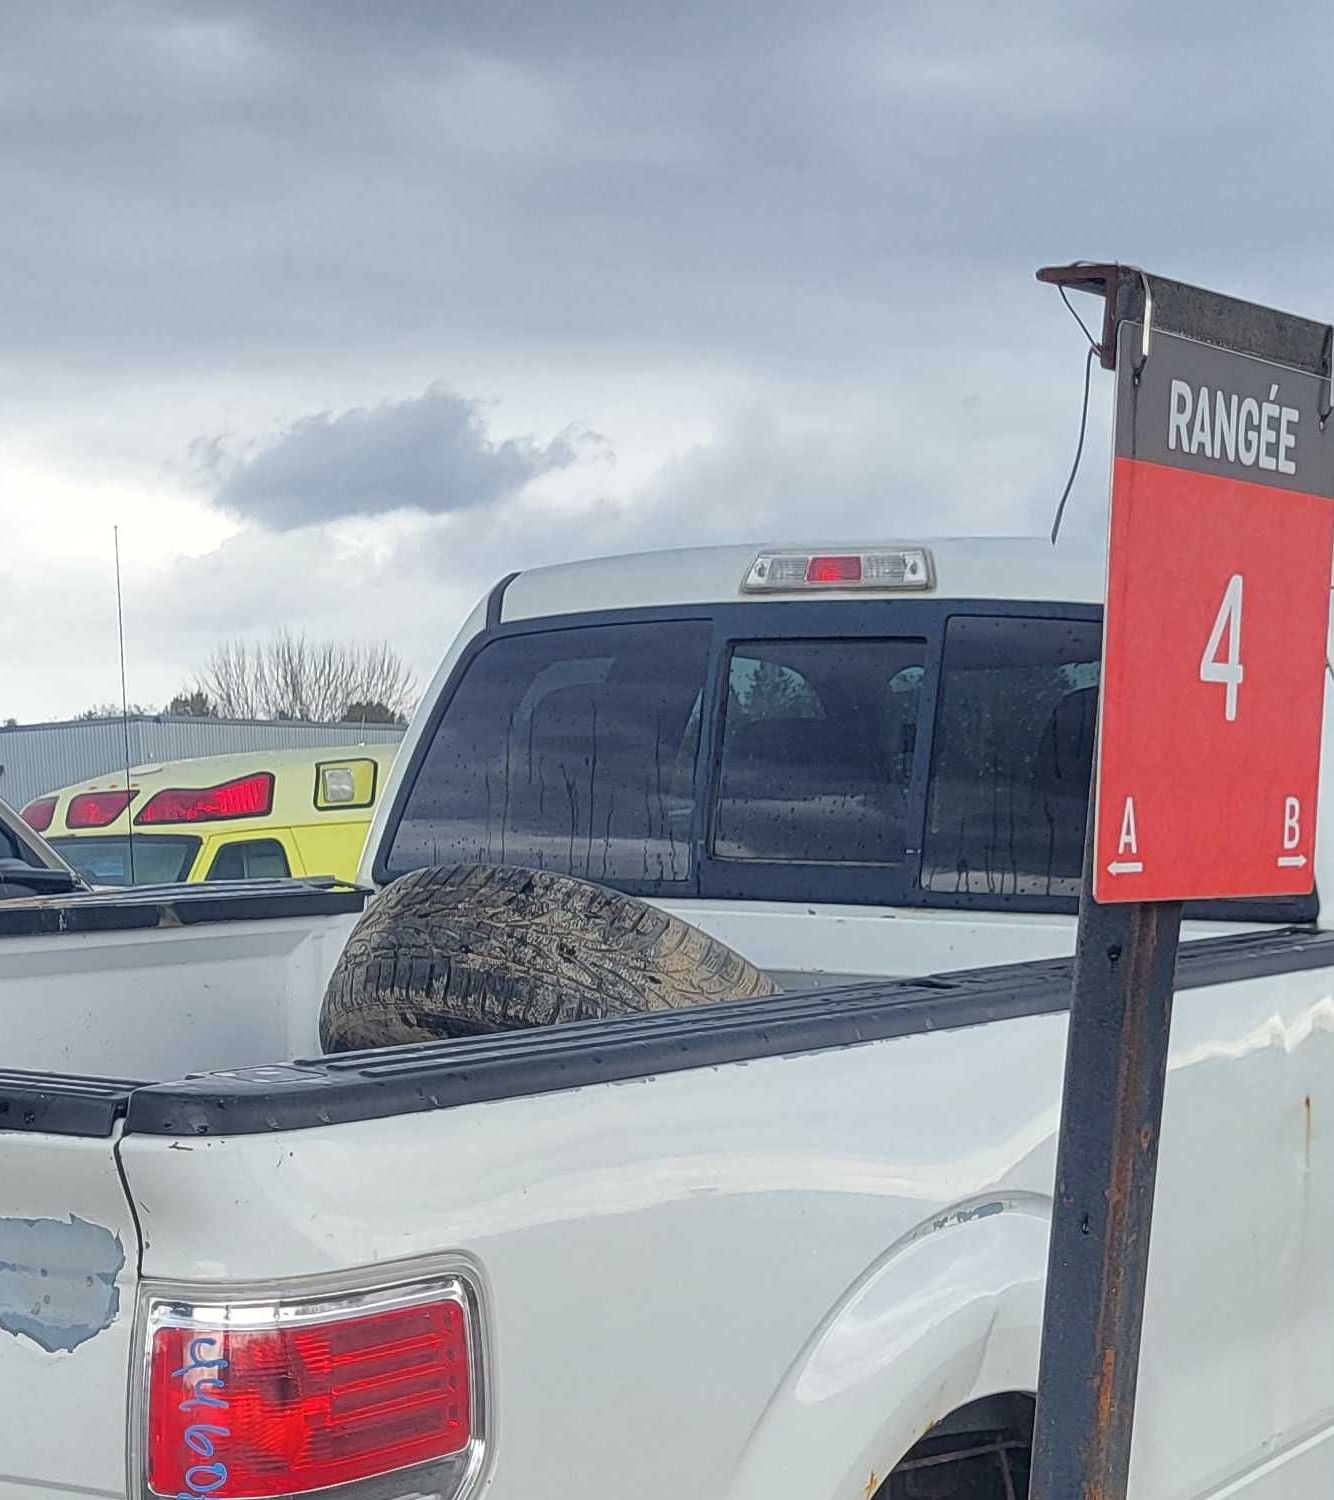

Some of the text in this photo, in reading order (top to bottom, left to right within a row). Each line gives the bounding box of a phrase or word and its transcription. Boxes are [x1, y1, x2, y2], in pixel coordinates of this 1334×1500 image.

[1167, 380, 1299, 475] RANGÉE
[1199, 573, 1244, 722] 4
[1118, 796, 1301, 854] A B
